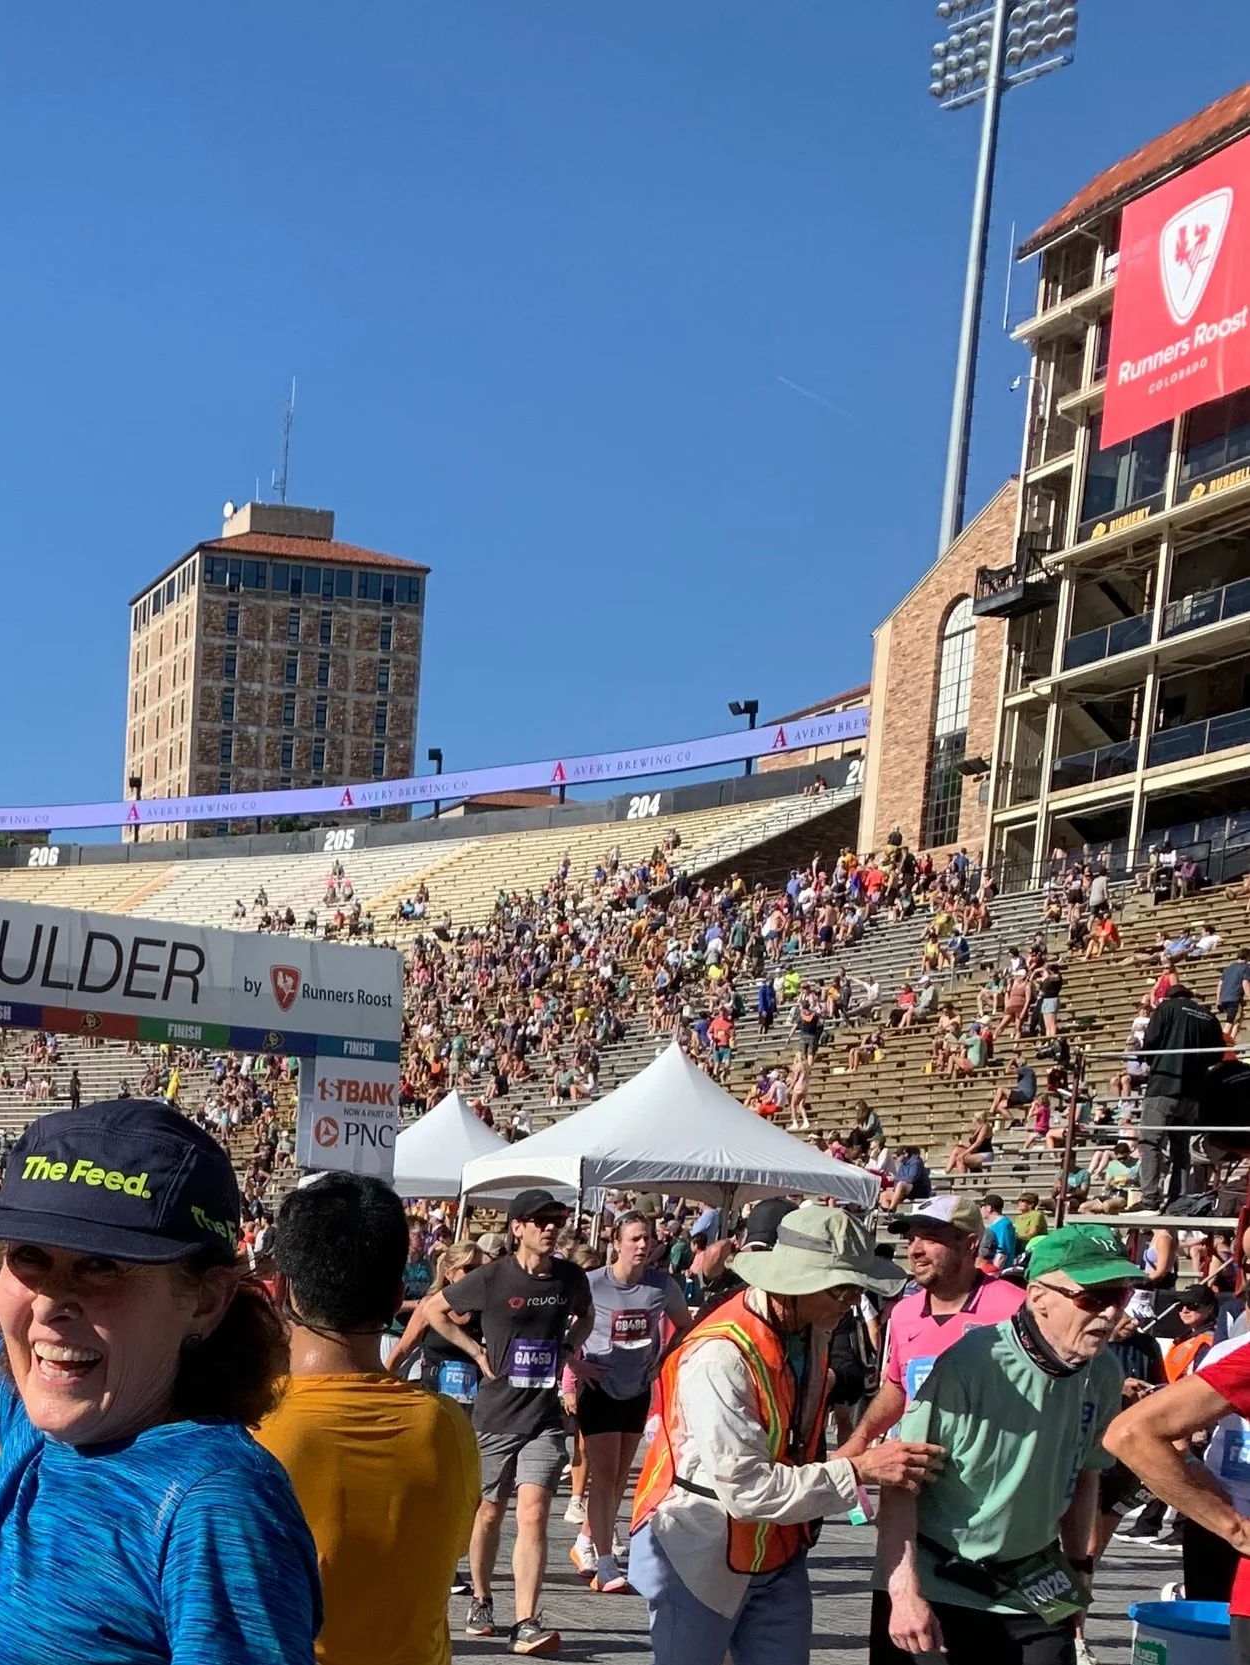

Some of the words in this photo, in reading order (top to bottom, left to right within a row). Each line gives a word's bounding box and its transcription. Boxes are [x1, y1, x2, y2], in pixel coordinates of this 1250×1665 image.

[1117, 336, 1191, 386] Runners
[1193, 305, 1248, 350] Roost
[1148, 357, 1208, 395] COLORADO
[794, 724, 832, 742] AVERY
[574, 762, 612, 776] AVERY
[617, 754, 672, 771] BREWING
[360, 787, 395, 802] AVERY
[399, 781, 449, 797] BREWING
[146, 806, 181, 817] AVERY
[185, 801, 238, 813] BREWING
[627, 792, 662, 820] 204
[323, 828, 356, 851] 205
[27, 846, 60, 867] 206
[244, 976, 262, 997] by
[302, 983, 354, 1004] Runners
[357, 989, 393, 1007] Roost
[167, 1022, 202, 1041] FINISH
[343, 1040, 376, 1057] FINISH
[318, 1077, 395, 1106] 1STBANK
[343, 1107, 360, 1116] NOW
[367, 1109, 384, 1118] PART
[385, 1111, 394, 1119] OF
[344, 1122, 393, 1148] PNC
[21, 1156, 68, 1181] The
[69, 1159, 151, 1199] Feed.
[190, 1205, 227, 1238] The
[615, 1319, 647, 1331] GB486
[514, 1351, 551, 1365] GA459
